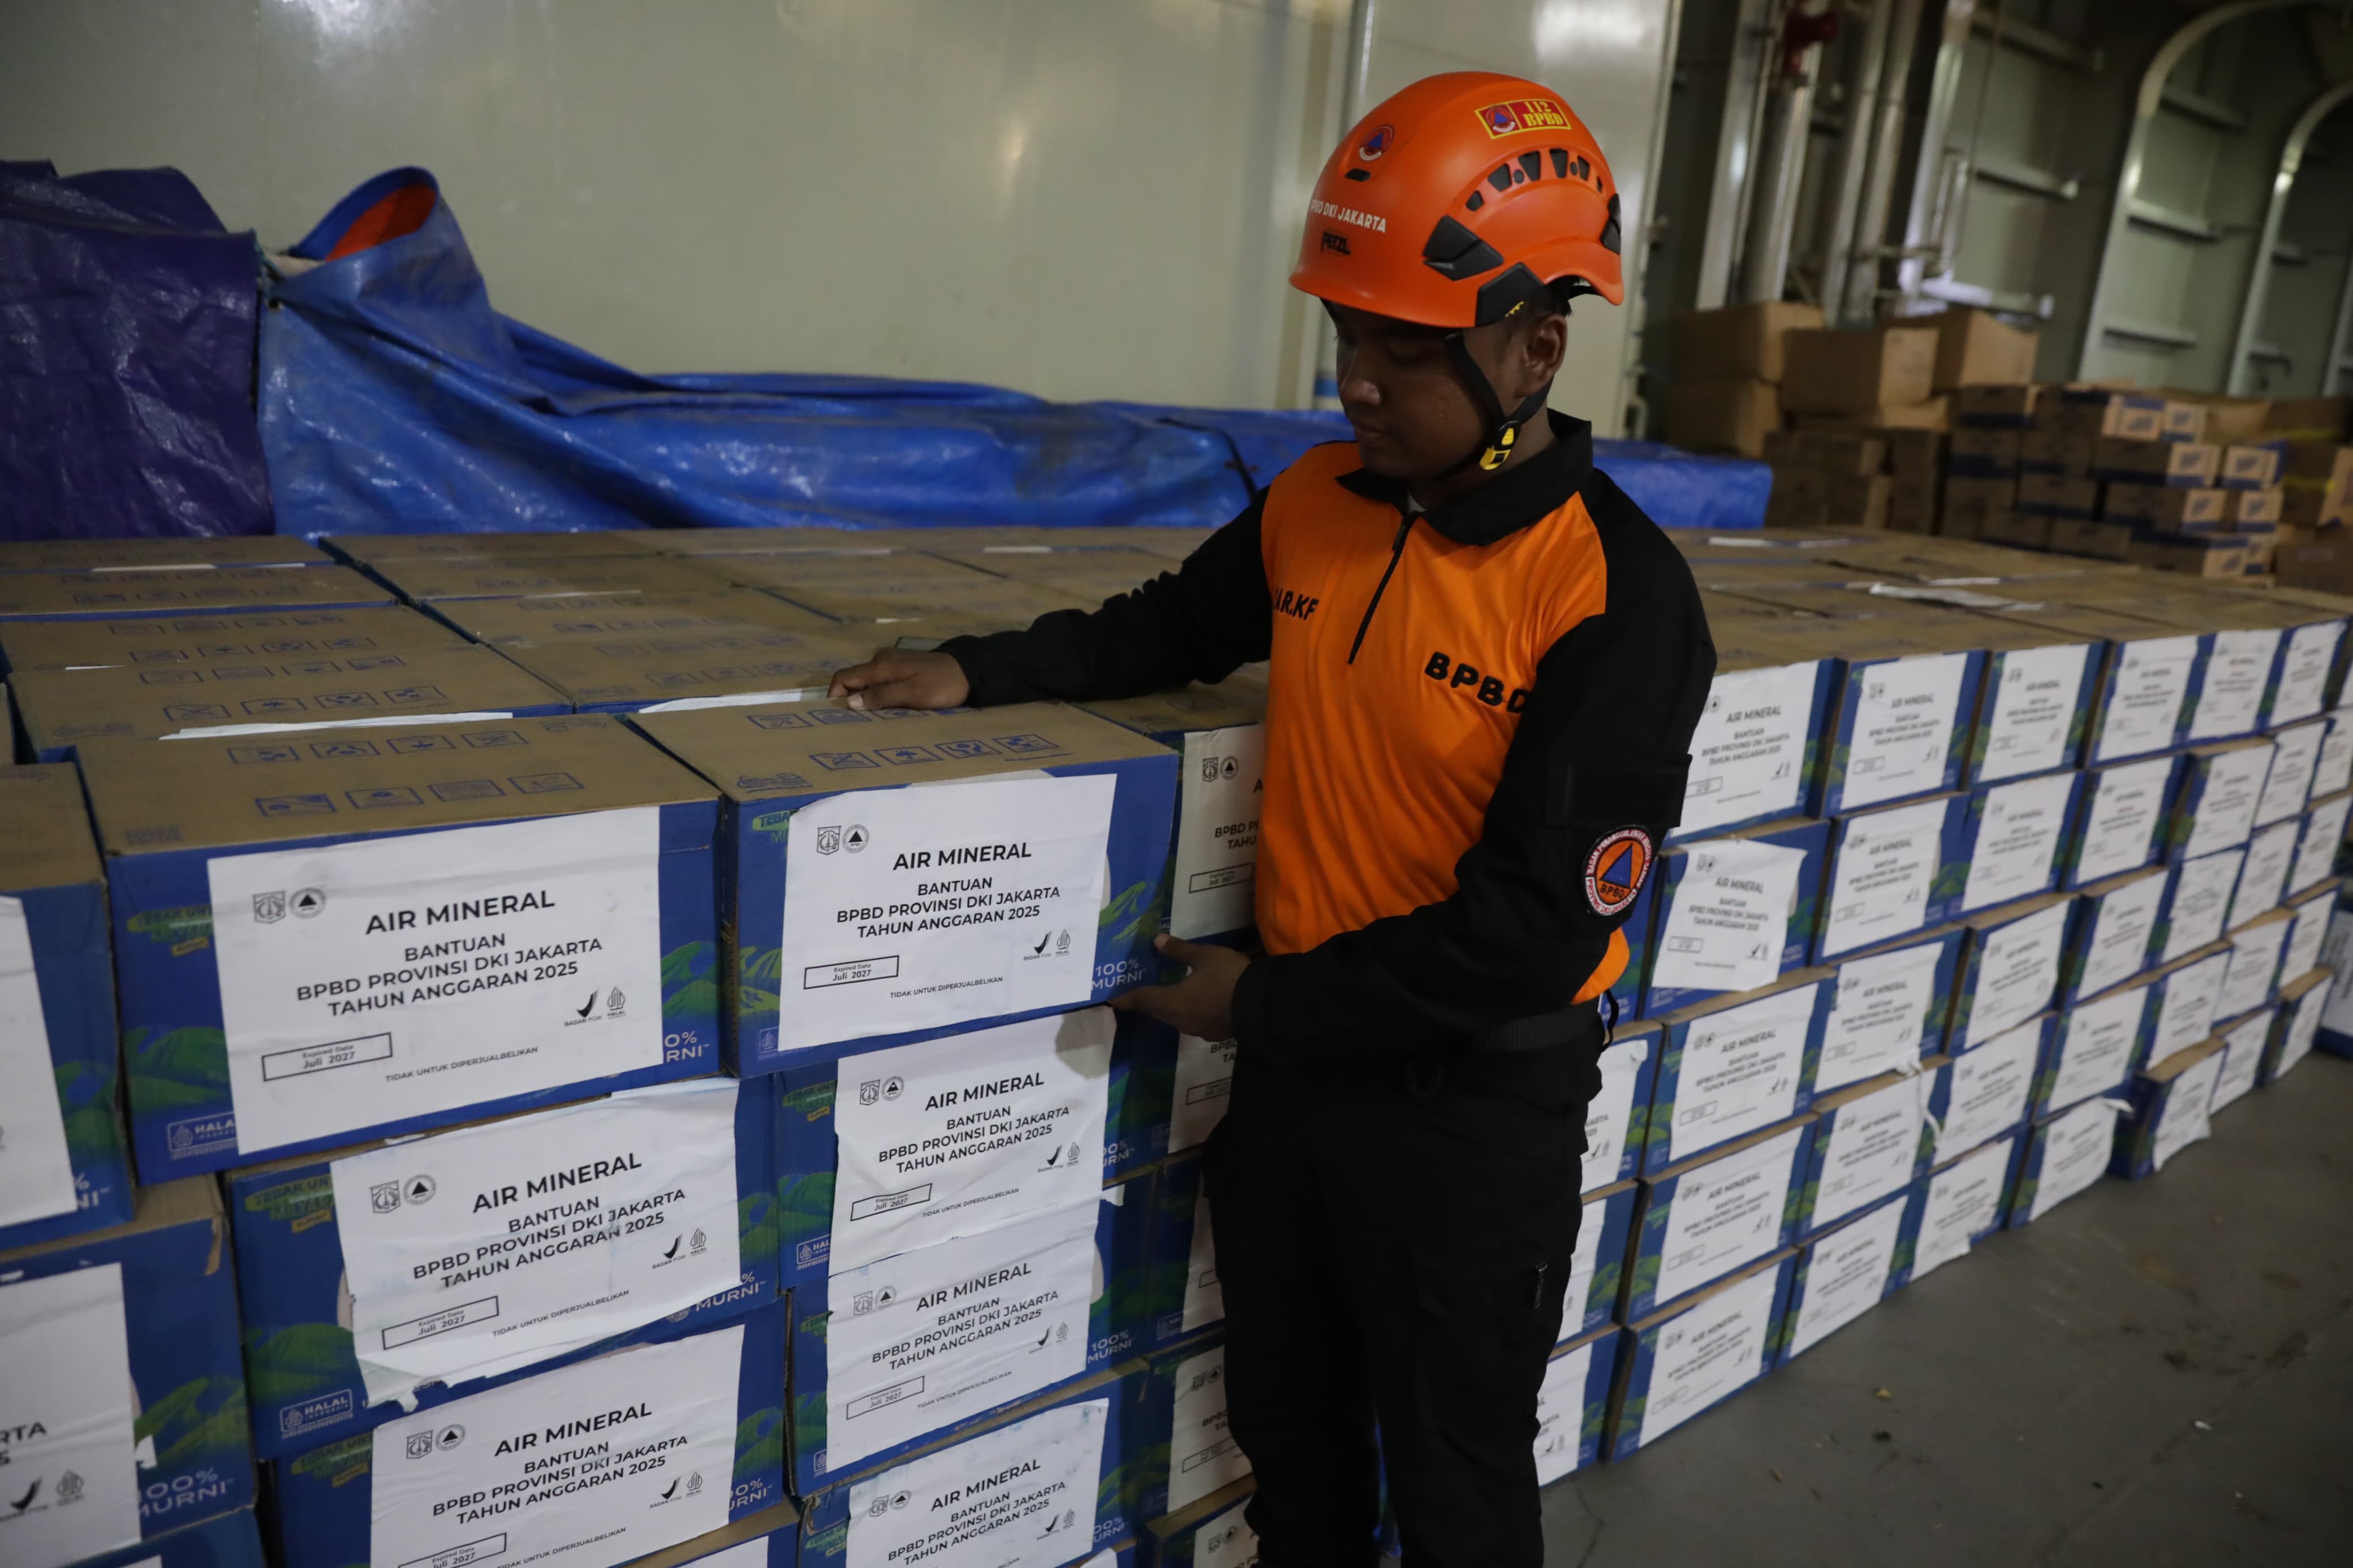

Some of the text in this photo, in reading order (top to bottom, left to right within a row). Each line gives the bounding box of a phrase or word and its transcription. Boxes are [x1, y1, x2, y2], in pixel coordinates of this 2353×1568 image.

[1523, 113, 1564, 127] BPBD
[1524, 101, 1552, 113] 112
[1323, 202, 1338, 218] DKI
[1338, 208, 1386, 233] JAKARTA
[1321, 231, 1351, 254] PETZL
[1425, 651, 1532, 714] BPBD
[1726, 706, 1781, 723] AIR MINERAL
[1214, 823, 1246, 839] BPBD
[1227, 836, 1257, 849] TAHU
[893, 842, 1032, 871] AIR MINERAL
[918, 877, 992, 896] BANTUAN
[366, 890, 555, 935] AIR MINERAL
[837, 886, 1060, 923] BPBD PROVINSI DKI JAKARTA
[857, 905, 1040, 938] TAHUN ANGGARAN 2025
[404, 933, 505, 962] BANTUAN
[297, 938, 602, 1001] BPBD PROVINSI DKI JAKARTA
[832, 969, 872, 981] Juli 2027
[1092, 970, 1142, 991] MURNI
[1096, 958, 1140, 978] 100%
[327, 961, 578, 1016] TAHUN ANGGARAN 2025
[913, 986, 937, 995] UNTUK
[938, 977, 1003, 991] DIPERJUALBELIKAN
[303, 1051, 355, 1069] Juli 2027
[385, 1047, 538, 1082] TIDAK UNTUK DIPERJUALBELIKAN
[666, 1045, 703, 1062] RNI
[925, 1072, 1044, 1111] AIR MINERAL
[195, 1119, 235, 1134] HALA
[947, 1105, 1011, 1130] BANTUAN
[879, 1107, 1070, 1163] BPBD PROVINSI DKI JAKARTA
[896, 1124, 1052, 1173] TAHUN ANGGARAN 2025
[473, 1152, 642, 1213] AIR MINERAL
[508, 1196, 600, 1233] BANTUAN
[874, 1197, 908, 1211] Juli 2027
[922, 1188, 1019, 1217] TIDAK UNTUK DIPERJUALBELIKAN
[413, 1189, 686, 1279] BPBD PROVINSI DKI JAKARTA
[441, 1211, 664, 1288] TAHUN ANGGARAN 2025
[696, 1282, 760, 1312] MURNI
[916, 1263, 1032, 1311] AIR MINERAL
[419, 1315, 466, 1335] Juli 2027
[492, 1290, 629, 1337] TIDAK UNTUK DIPERJUALBELIKAN
[872, 1290, 1058, 1363] BPBD PROVINSI DKI JAKARTA
[938, 1297, 999, 1326] BANTUAN
[889, 1308, 1041, 1370] TAHUN ANGGARAN 2025
[1088, 1338, 1132, 1363] MURNI
[1091, 1329, 1130, 1351] 100%
[304, 1396, 349, 1415] HALAL
[869, 1391, 902, 1408] Juli 2027
[917, 1371, 1012, 1409] TIDAK UNTUK DIPERJUALBELIKAN
[494, 1403, 652, 1457] AIR MINERAL
[524, 1441, 609, 1474] BANTUAN
[146, 1467, 218, 1498] 00%
[433, 1436, 688, 1516] BPBD PROVINSI DKI JAKARTA
[456, 1455, 666, 1524] TAHUN ANGGARAN 2025
[931, 1459, 1041, 1511] AIR MINERAL
[888, 1481, 1066, 1561] BPBD PROVINSI DKI JAKARTA
[951, 1491, 1010, 1523] BANTUAN
[523, 1527, 626, 1563] UNTUK DIPERJUALBELIKAN
[904, 1498, 1050, 1566] TAHUN ANGGARAN 2025
[1093, 1522, 1125, 1543] URNI
[432, 1550, 458, 1563] Expired
[453, 1552, 476, 1565] 2027
